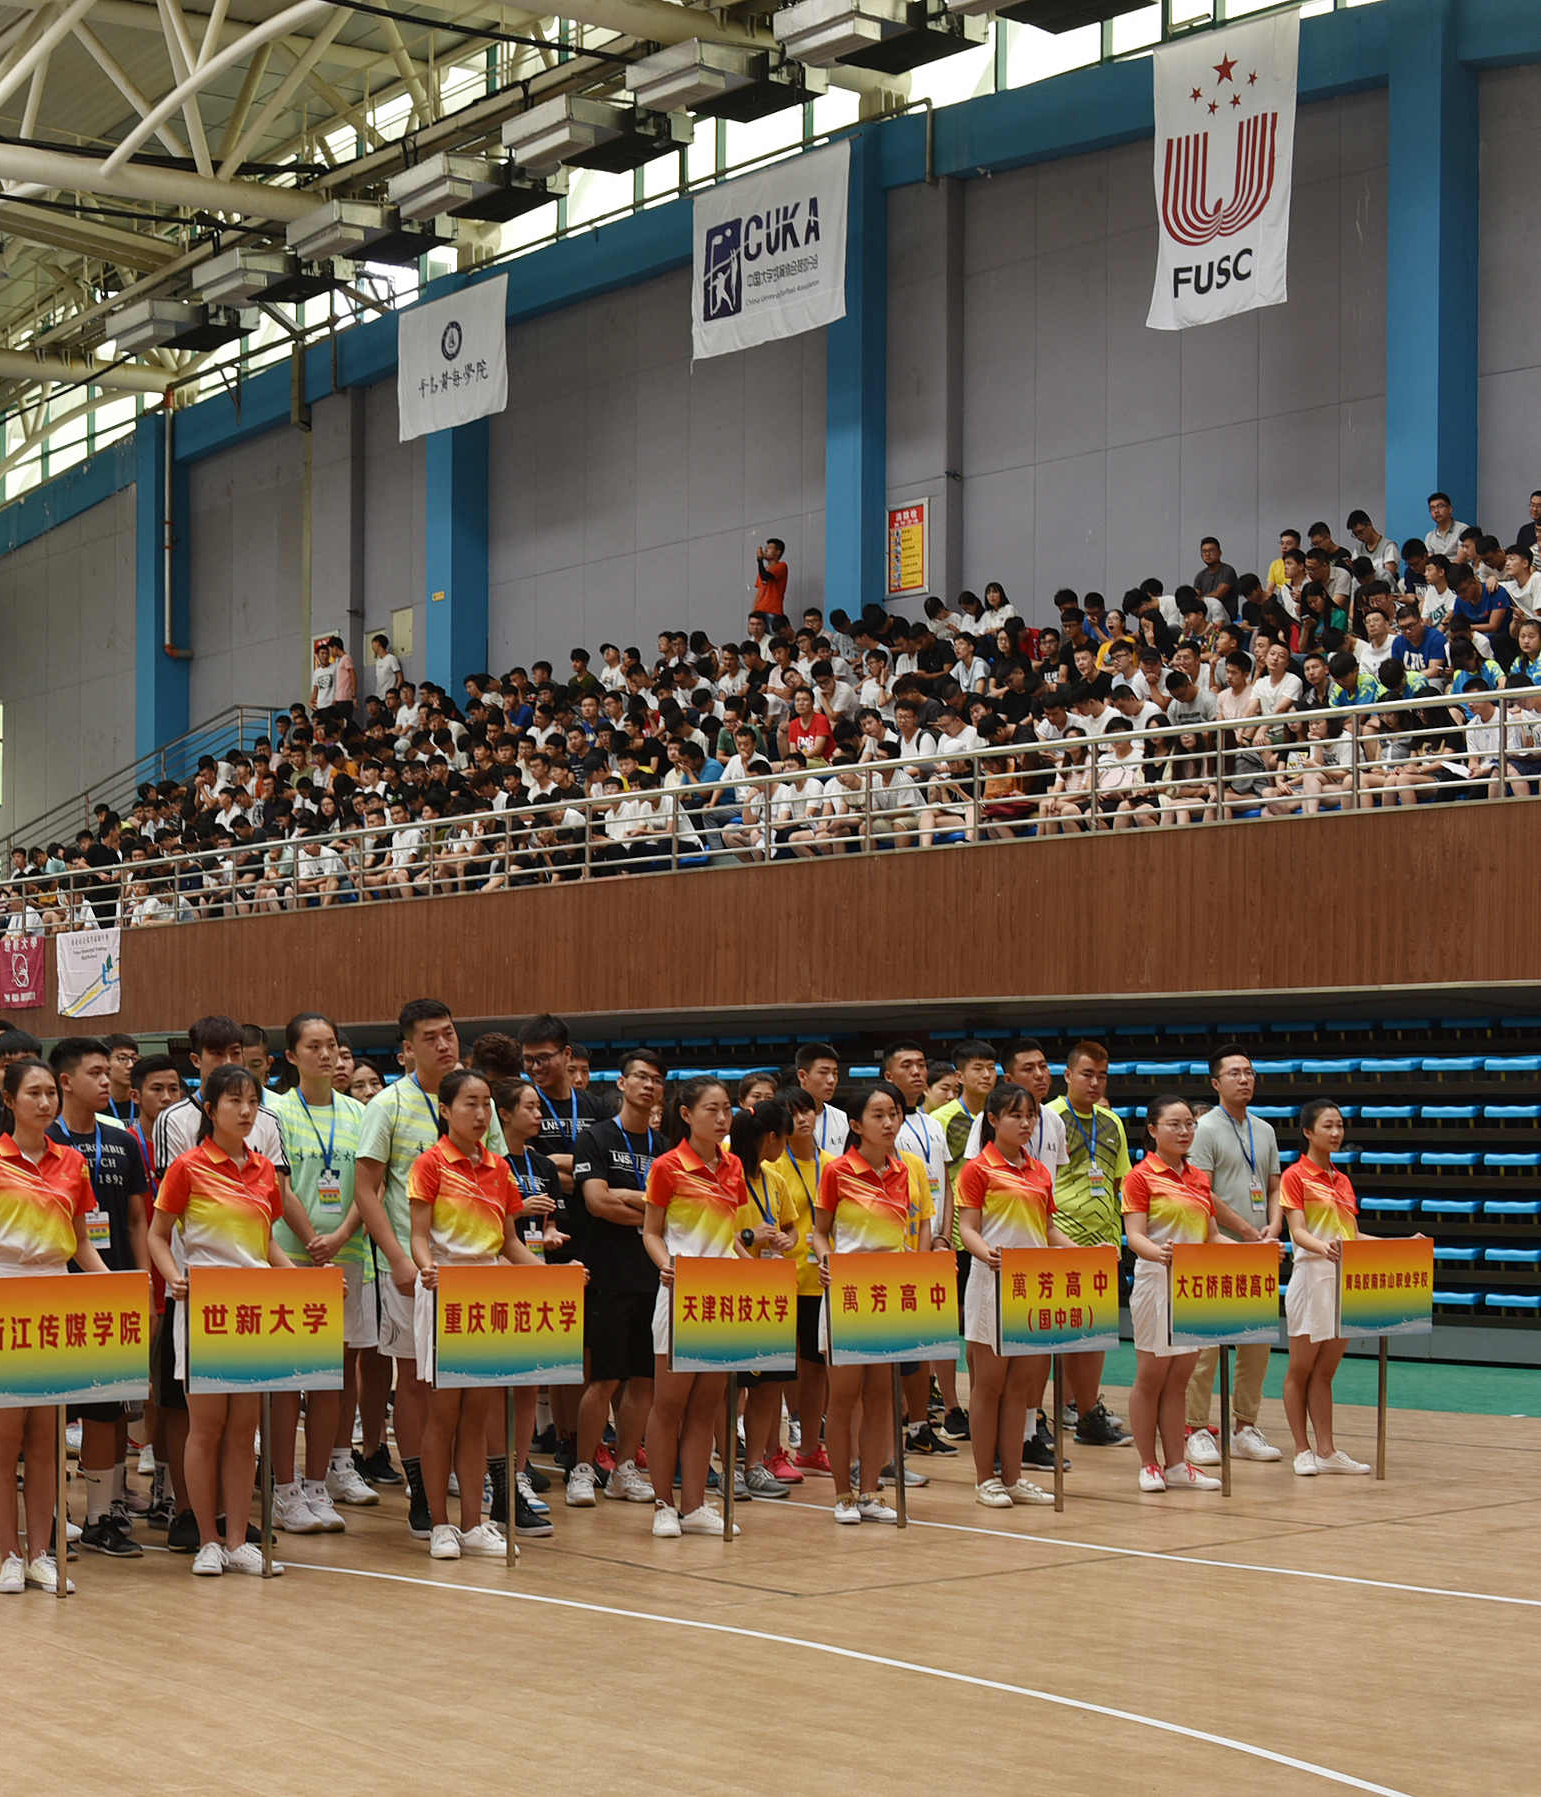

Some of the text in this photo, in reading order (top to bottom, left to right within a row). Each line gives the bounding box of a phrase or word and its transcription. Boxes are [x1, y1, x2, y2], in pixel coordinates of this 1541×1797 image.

[743, 197, 821, 262] CUKA
[1173, 248, 1253, 299] FUSC
[842, 1282, 947, 1313] 萬芳高中
[1012, 1269, 1108, 1300] 萬芳高中
[1176, 1273, 1276, 1299] 大石桥南楼高中
[202, 1302, 328, 1336] 世新大学
[443, 1300, 577, 1335] 重庆师范大学
[682, 1294, 789, 1323] 天津科技大学
